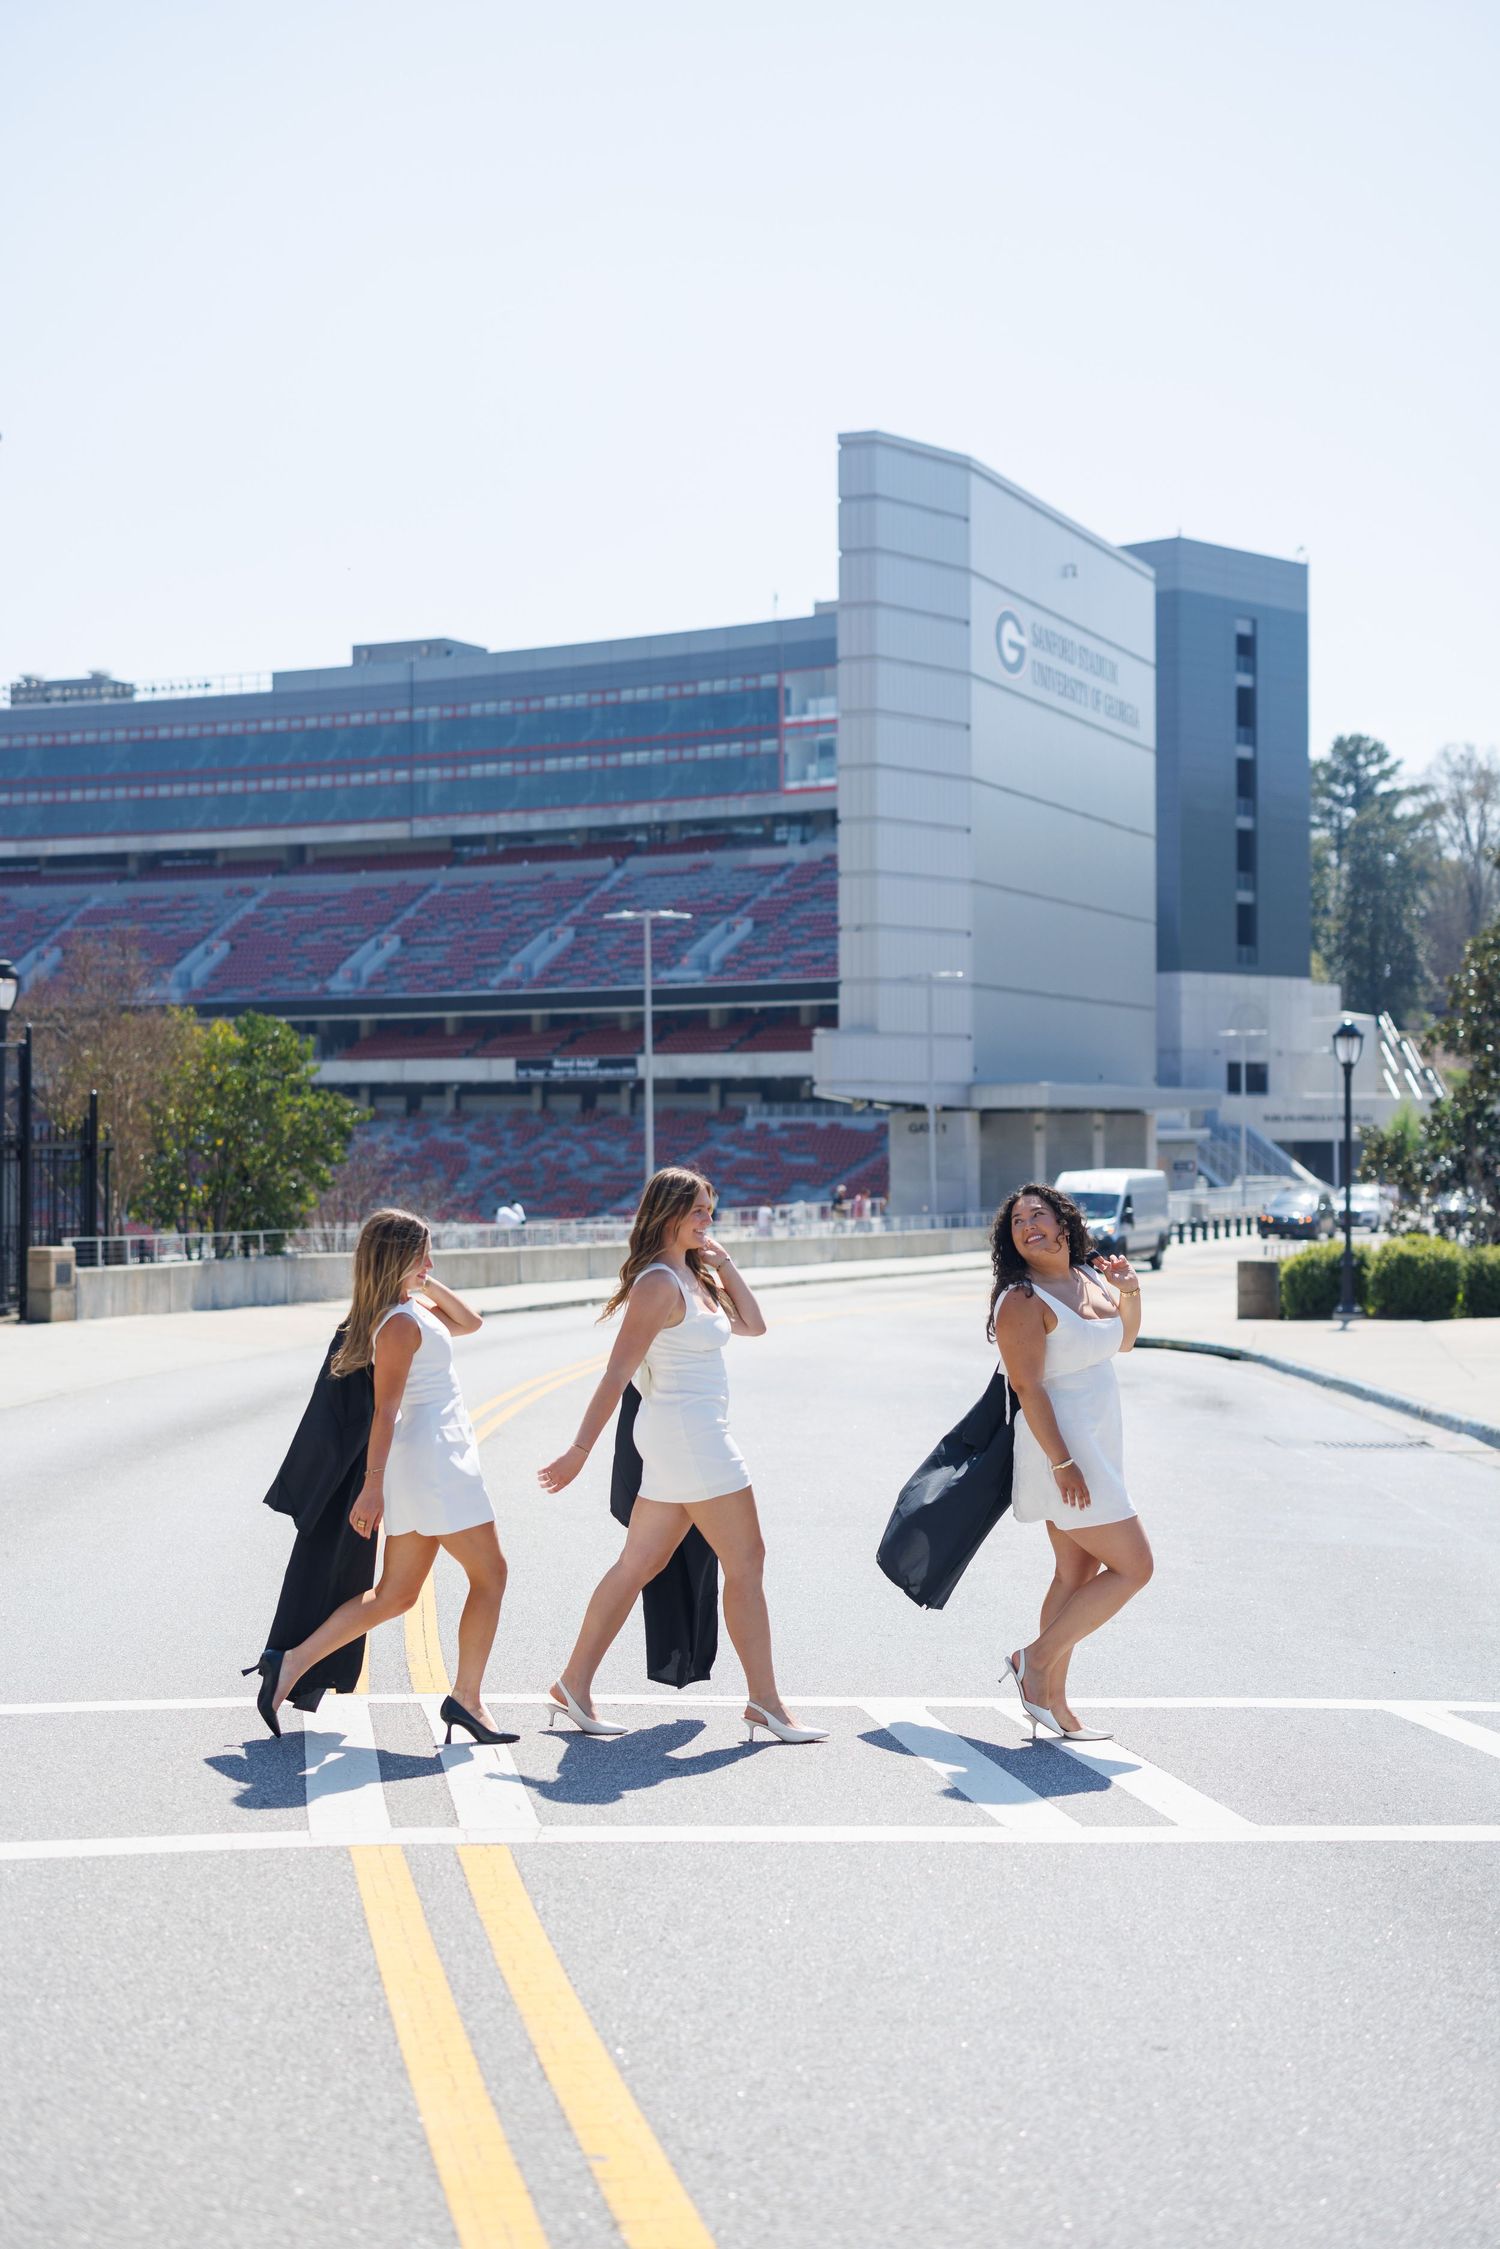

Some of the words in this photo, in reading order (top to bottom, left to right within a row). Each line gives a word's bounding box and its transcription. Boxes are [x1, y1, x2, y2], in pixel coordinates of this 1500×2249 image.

[995, 610, 1026, 675] G
[1031, 623, 1077, 665] SANFORD
[1078, 645, 1119, 685] STADIUM
[1031, 660, 1087, 707] UNIVERSITY
[1090, 687, 1102, 713] OF
[1104, 694, 1140, 728] GEORGIA
[908, 1122, 938, 1134] GAT
